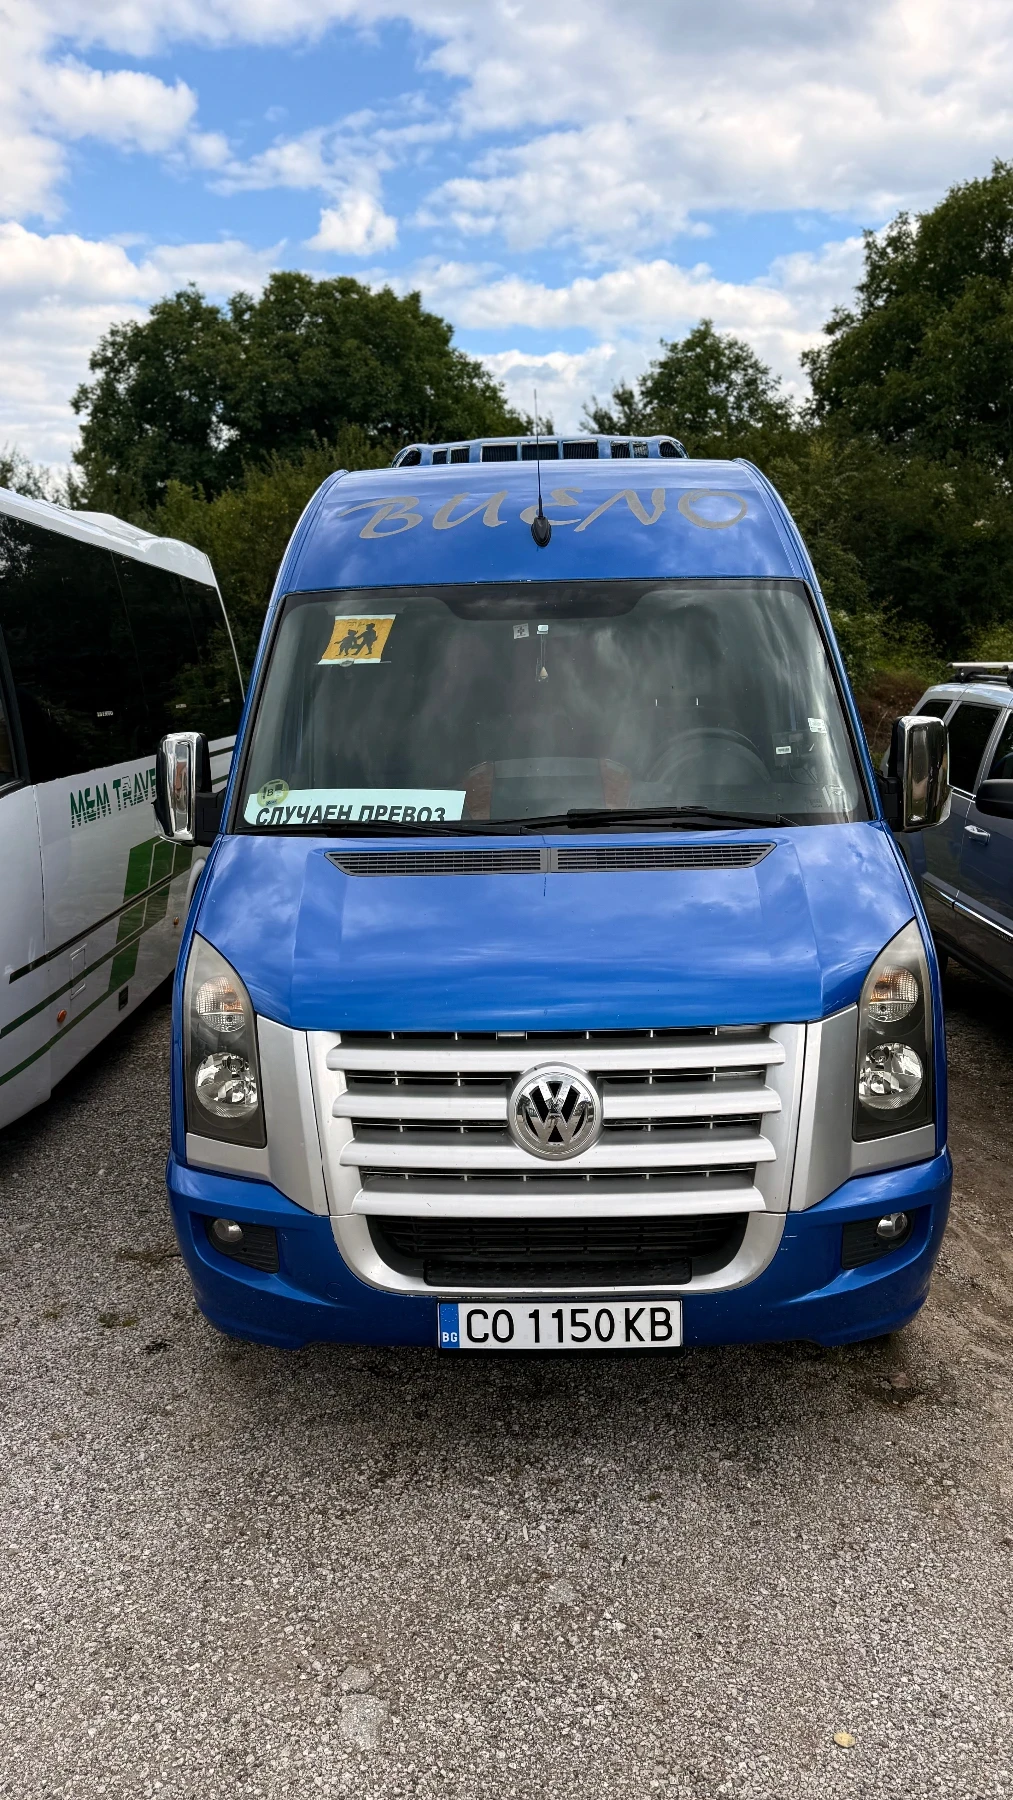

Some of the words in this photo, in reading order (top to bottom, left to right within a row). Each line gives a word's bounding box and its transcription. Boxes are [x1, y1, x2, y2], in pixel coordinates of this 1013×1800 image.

[339, 487, 748, 539] BUENO
[70, 783, 112, 828] M&M
[112, 768, 156, 811] TRAVE
[256, 805, 353, 825] СЛУЧАЕН
[358, 805, 446, 822] ПРЕВОЗ
[514, 1072, 596, 1152] VW
[442, 1331, 459, 1344] BG
[466, 1308, 515, 1344] CO
[528, 1308, 616, 1344] 1150
[624, 1307, 674, 1342] KB
